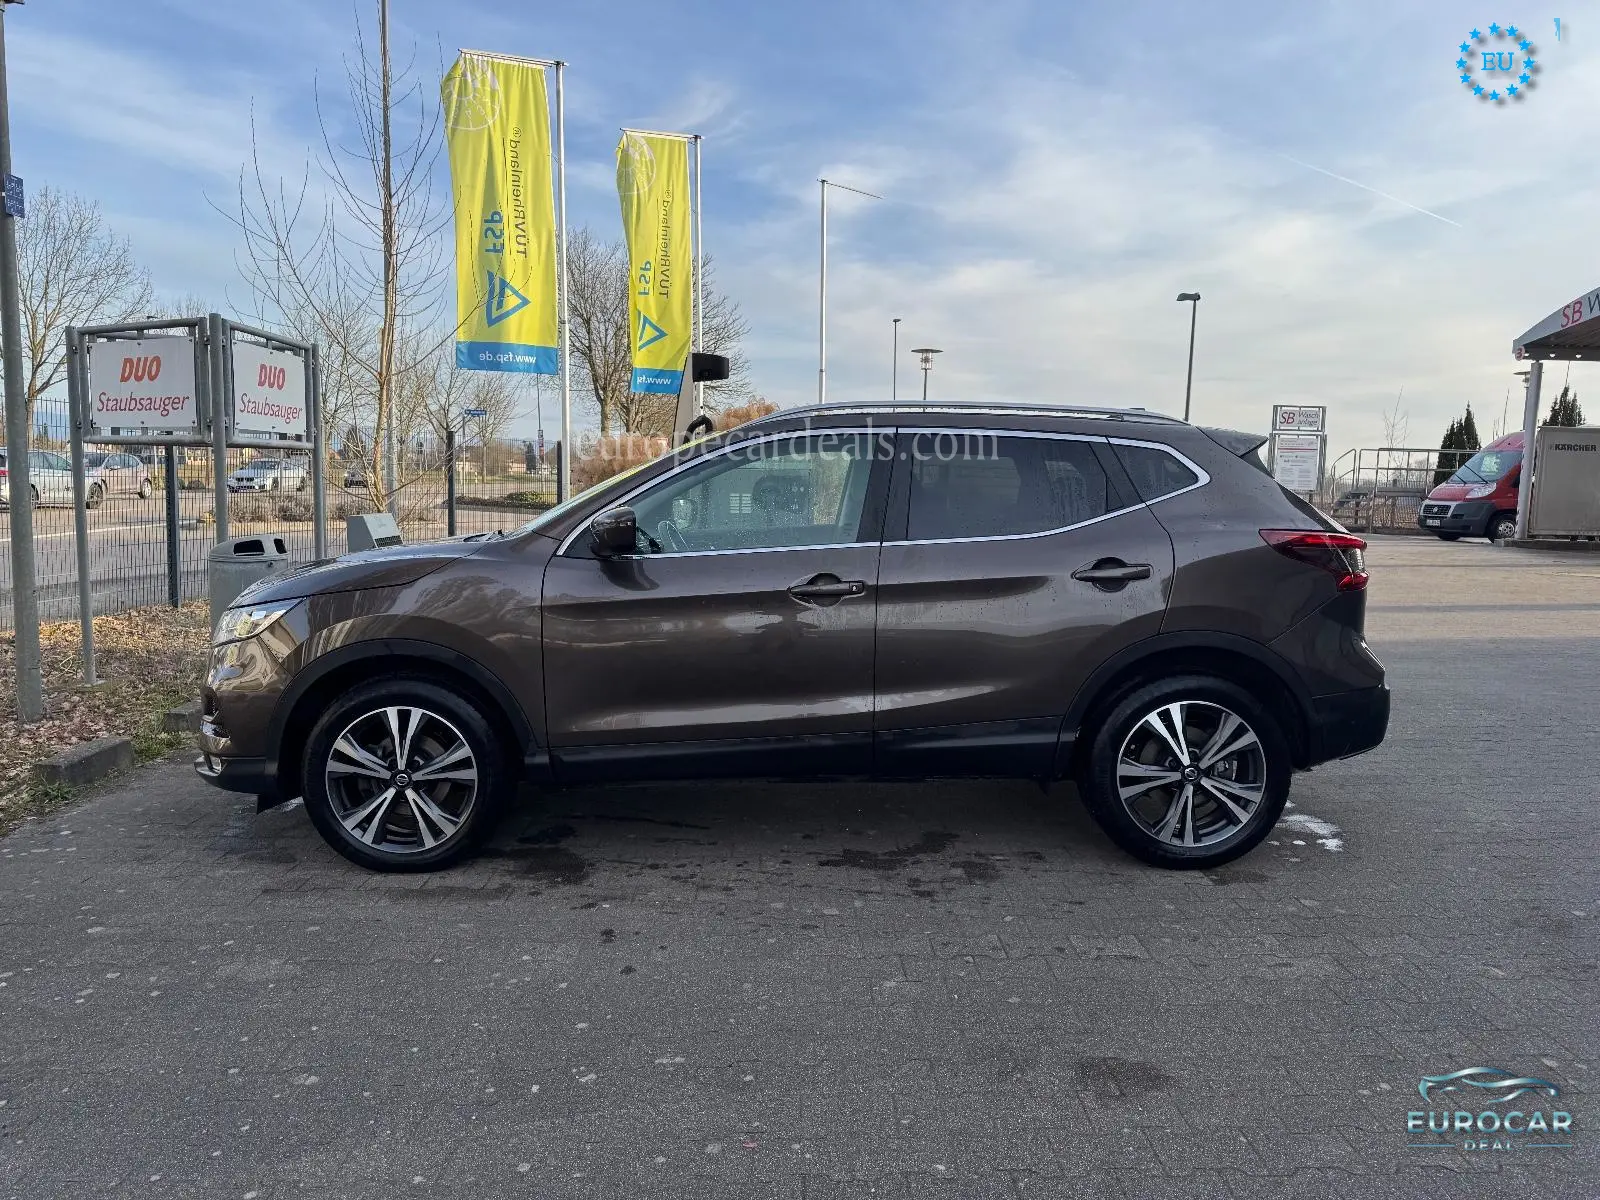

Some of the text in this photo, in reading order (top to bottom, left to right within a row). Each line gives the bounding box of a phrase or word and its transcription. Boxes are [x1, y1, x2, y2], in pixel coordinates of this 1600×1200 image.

[1561, 300, 1583, 328] SB
[119, 355, 162, 383] DUO
[257, 363, 286, 390] DUO
[97, 391, 190, 417] Staubsauger
[239, 392, 304, 424] Staubsauger
[1280, 411, 1295, 424] SB
[1554, 443, 1597, 452] KÄRCHER
